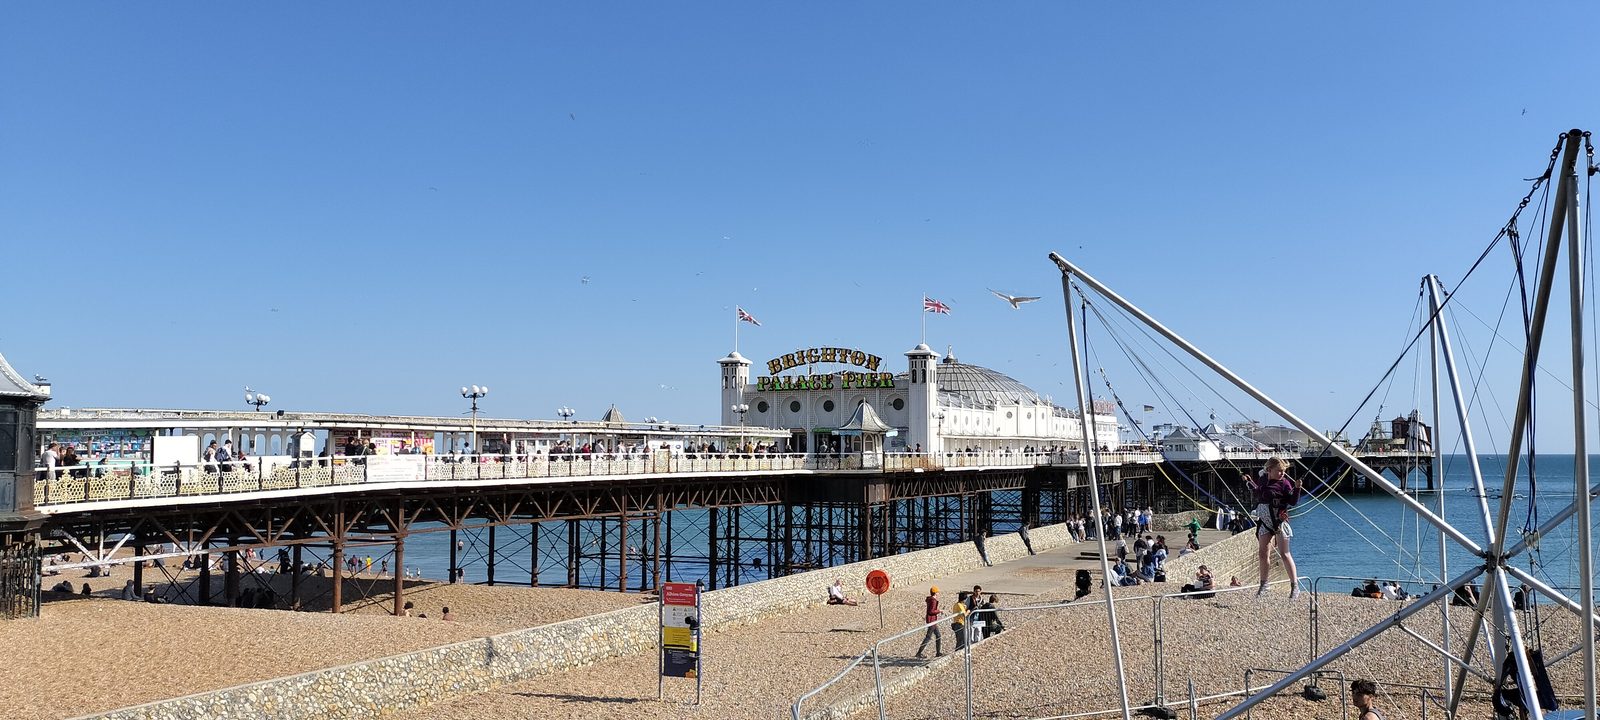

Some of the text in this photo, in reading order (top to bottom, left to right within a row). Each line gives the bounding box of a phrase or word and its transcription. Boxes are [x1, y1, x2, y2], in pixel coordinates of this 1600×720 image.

[766, 347, 883, 375] BRIGHTON
[757, 372, 896, 391] PALACE PIER
